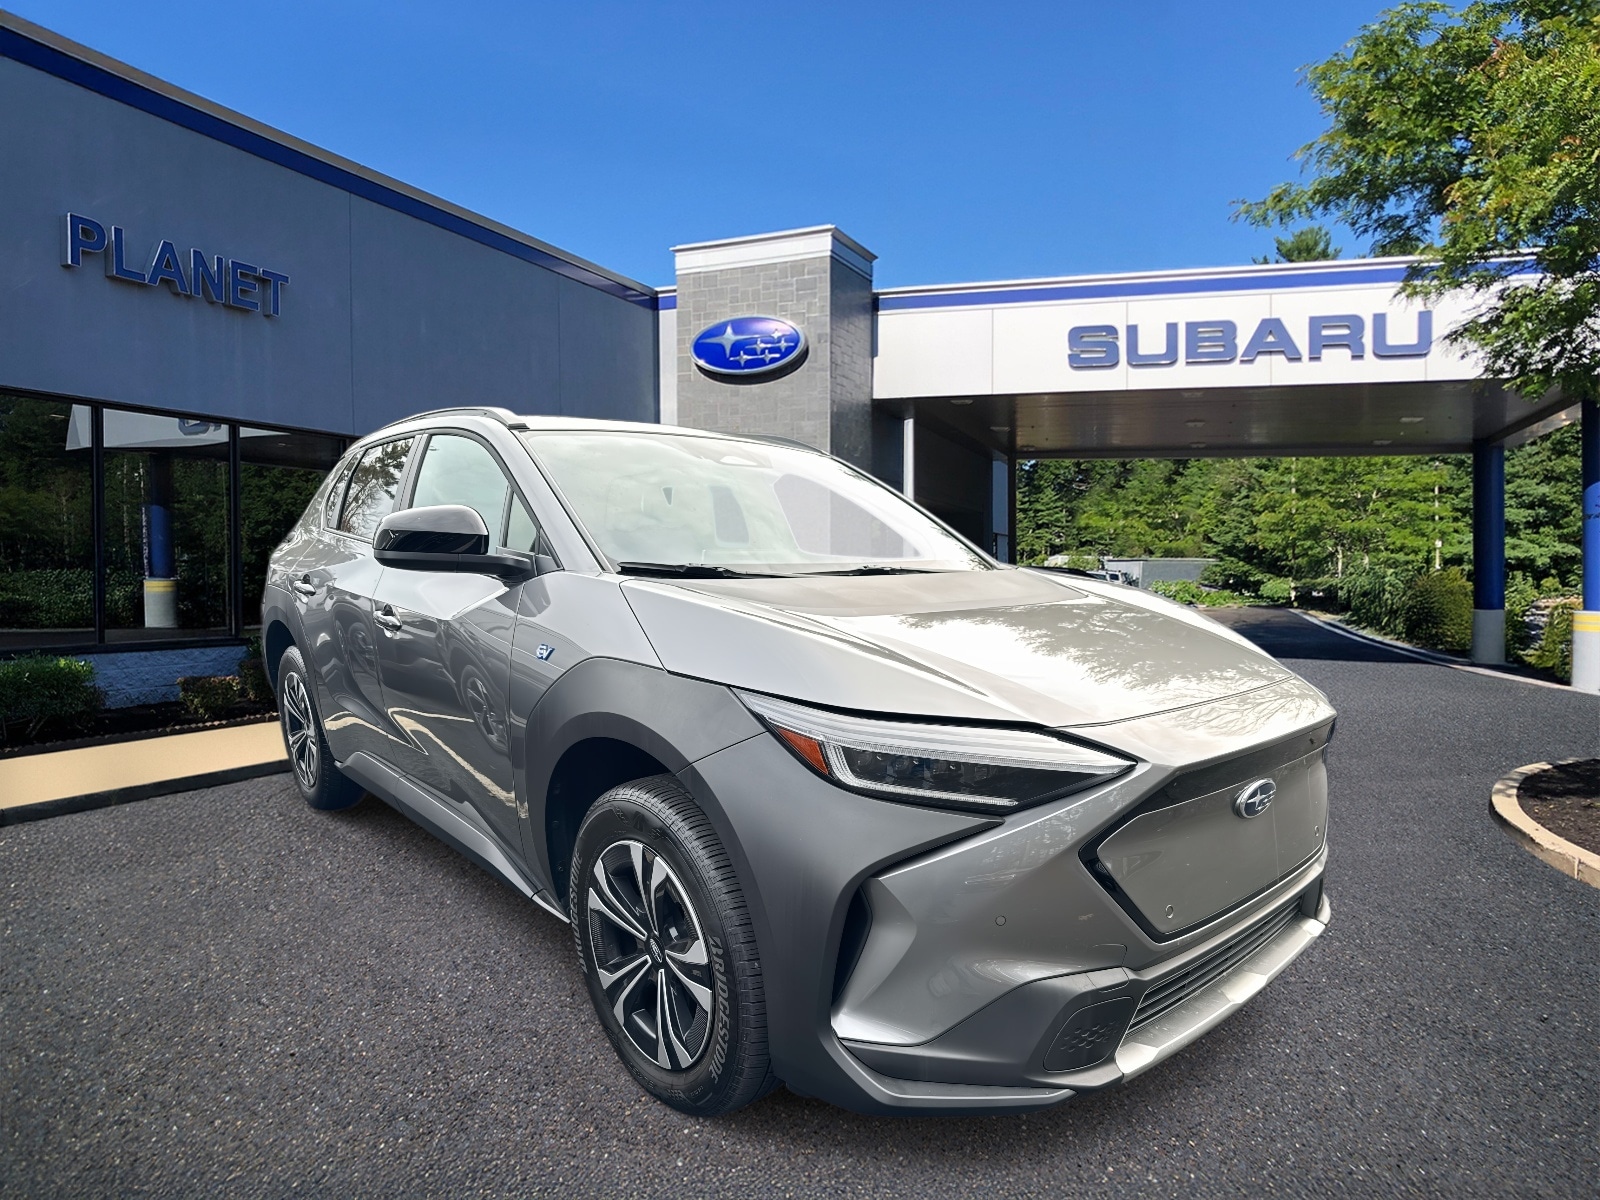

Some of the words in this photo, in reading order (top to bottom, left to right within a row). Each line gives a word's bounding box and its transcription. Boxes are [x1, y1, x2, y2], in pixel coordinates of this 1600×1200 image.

[63, 212, 290, 317] PLANET
[1067, 309, 1433, 370] SUBARU
[707, 934, 731, 1085] BRIDGESTONE
